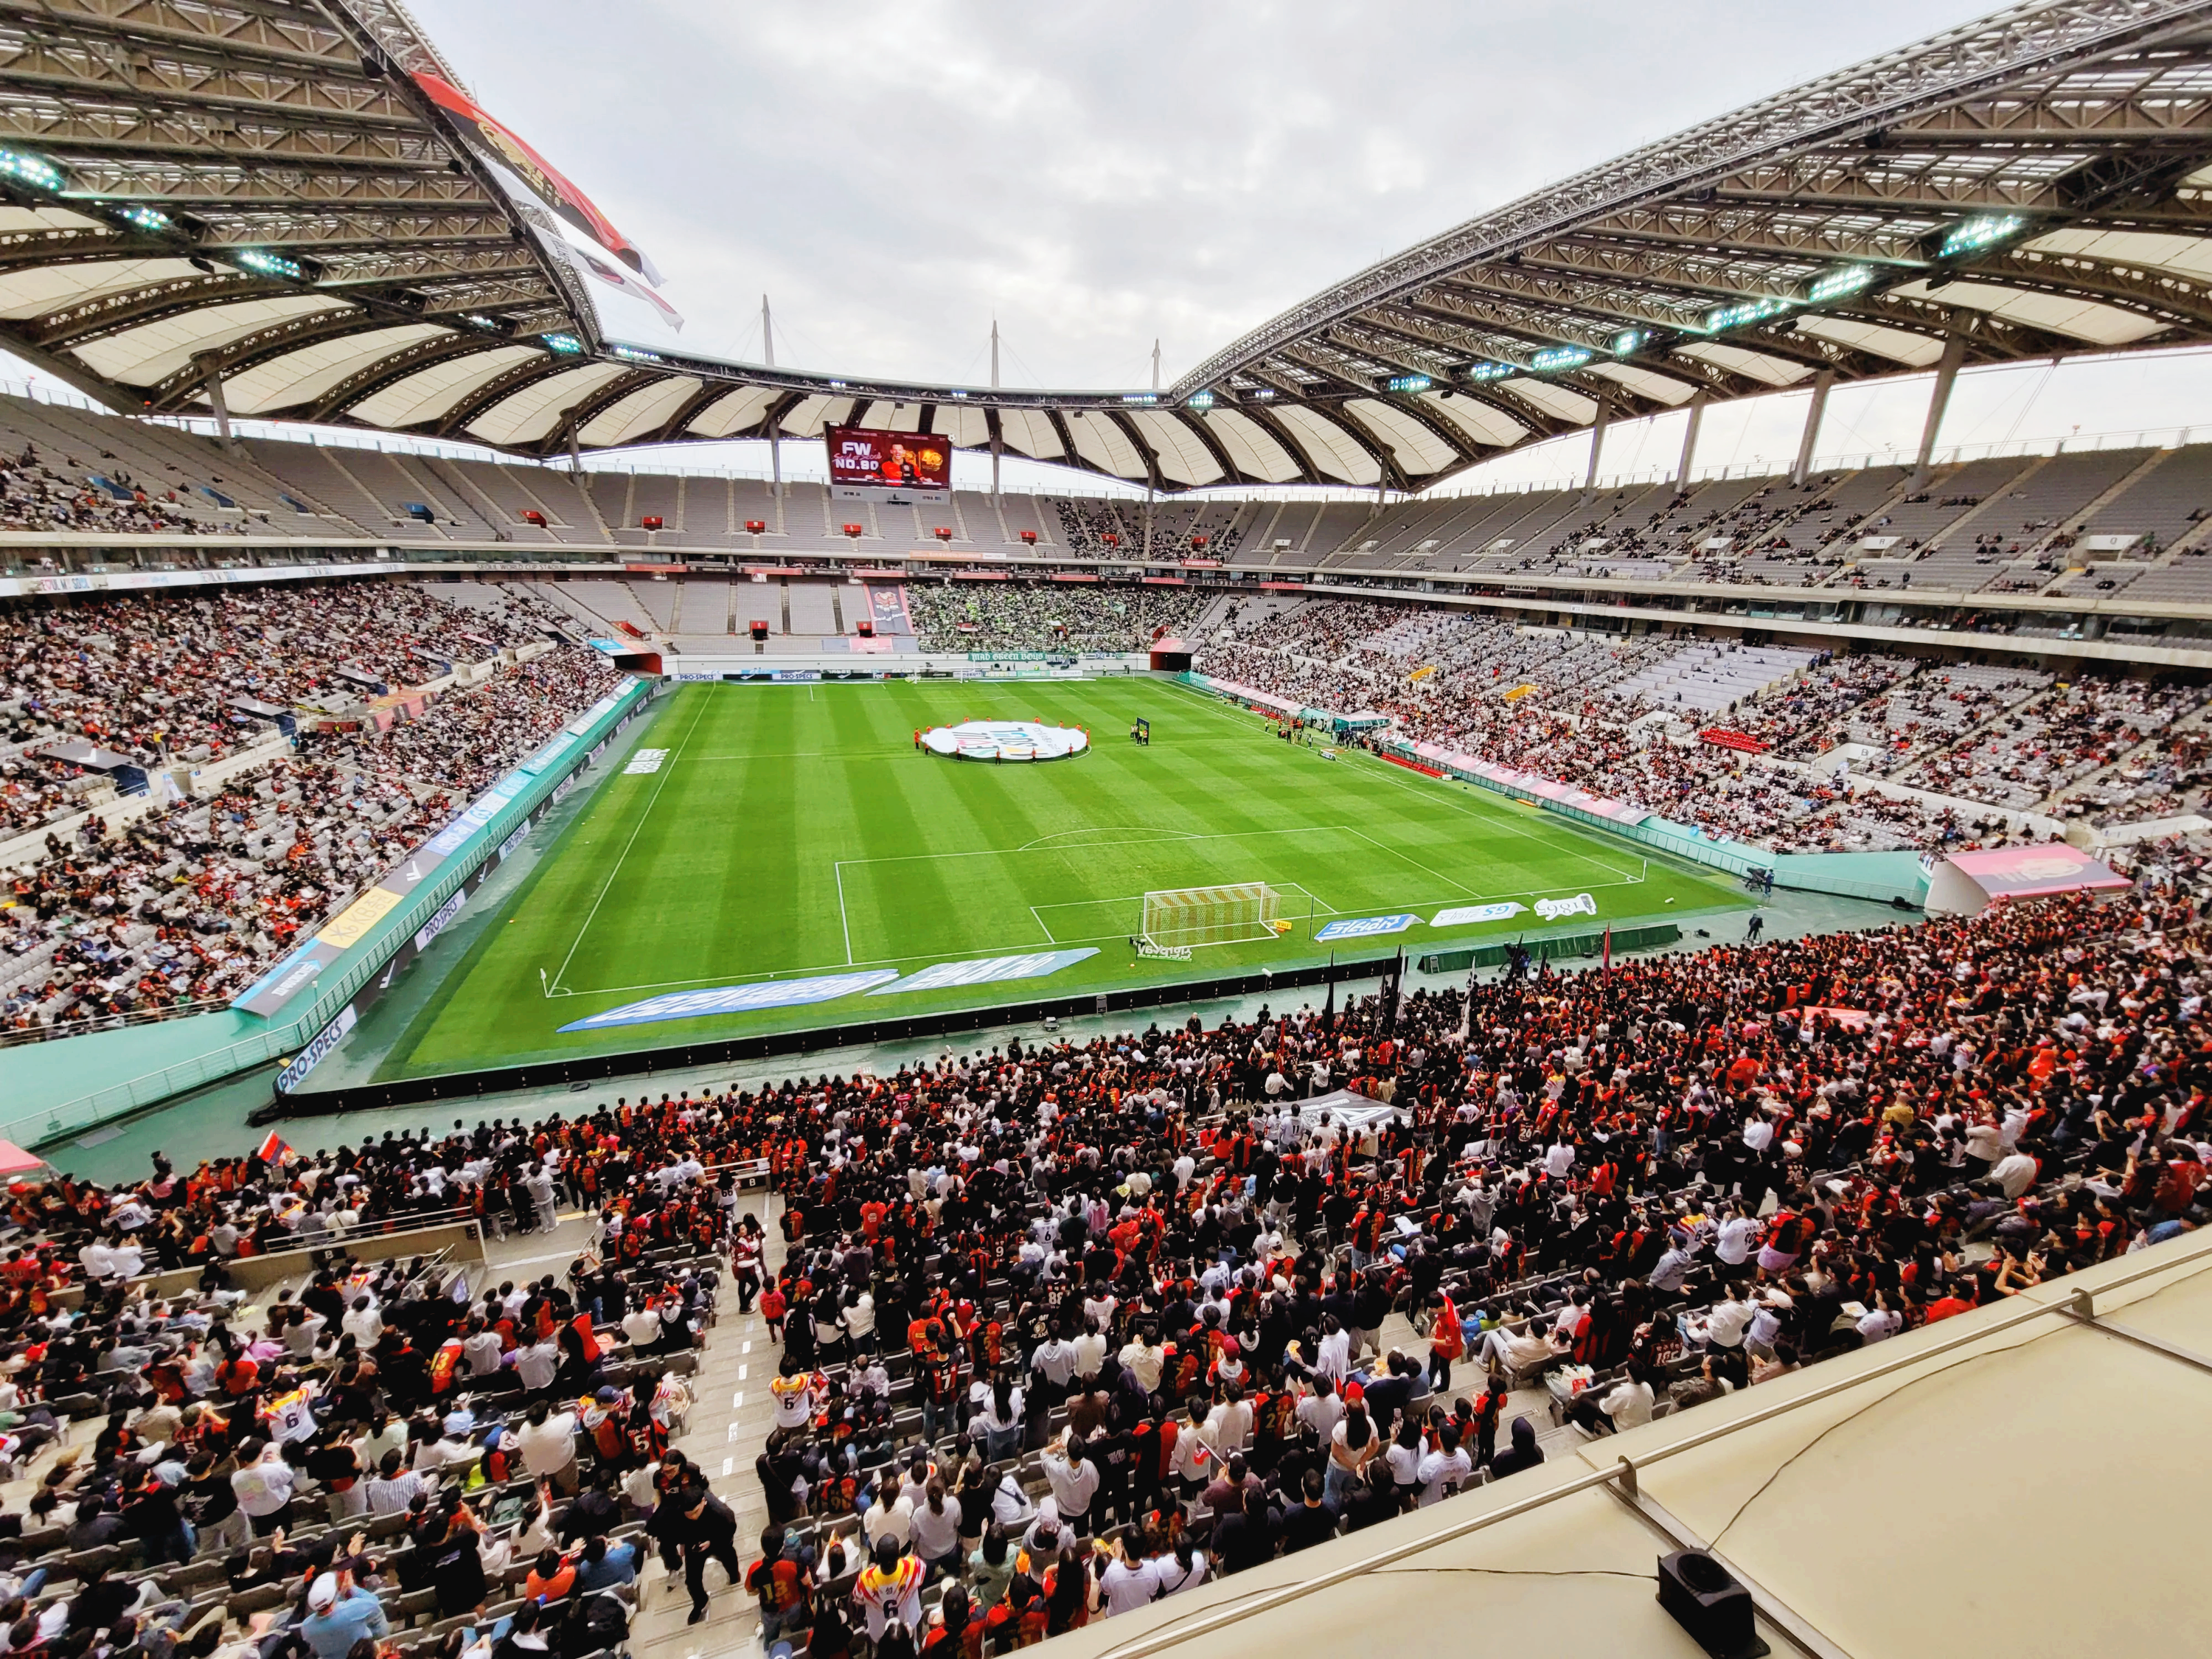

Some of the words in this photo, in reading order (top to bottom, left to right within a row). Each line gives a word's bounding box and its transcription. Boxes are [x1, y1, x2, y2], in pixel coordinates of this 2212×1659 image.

[842, 442, 872, 455] FW
[992, 653, 1020, 661] GREEN
[1021, 653, 1043, 661] BOYS
[1861, 748, 1868, 757] B
[504, 823, 526, 855] PRO-SPECS
[350, 892, 394, 926] KB증권
[1439, 907, 1481, 922] 칼텍스
[1482, 905, 1509, 917] GS
[1536, 900, 1579, 917] 1865
[424, 897, 457, 941] PRO-SPECS
[1323, 914, 1400, 936] 신한카드
[279, 1020, 342, 1091] PRO-SPECS
[1292, 1124, 1299, 1135] 11
[1520, 1127, 1532, 1138] 26
[748, 1178, 756, 1186] B
[1787, 1170, 1801, 1182] 20
[720, 1187, 734, 1197] 66
[1382, 1190, 1391, 1201] 5
[118, 1212, 134, 1222] 90
[605, 1228, 612, 1237] 6
[1044, 1230, 1051, 1242] 6
[1694, 1229, 1703, 1242] 6
[324, 1250, 334, 1259] B
[995, 1246, 1004, 1257] 9
[1048, 1292, 1063, 1304] 88
[431, 1351, 450, 1371] 13
[941, 1373, 951, 1390] 7
[785, 1397, 795, 1410] 5
[285, 1413, 299, 1429] 6
[184, 1441, 199, 1455] 5
[634, 1435, 649, 1452] 5
[762, 1581, 787, 1600] 13
[883, 1599, 898, 1619] 6
